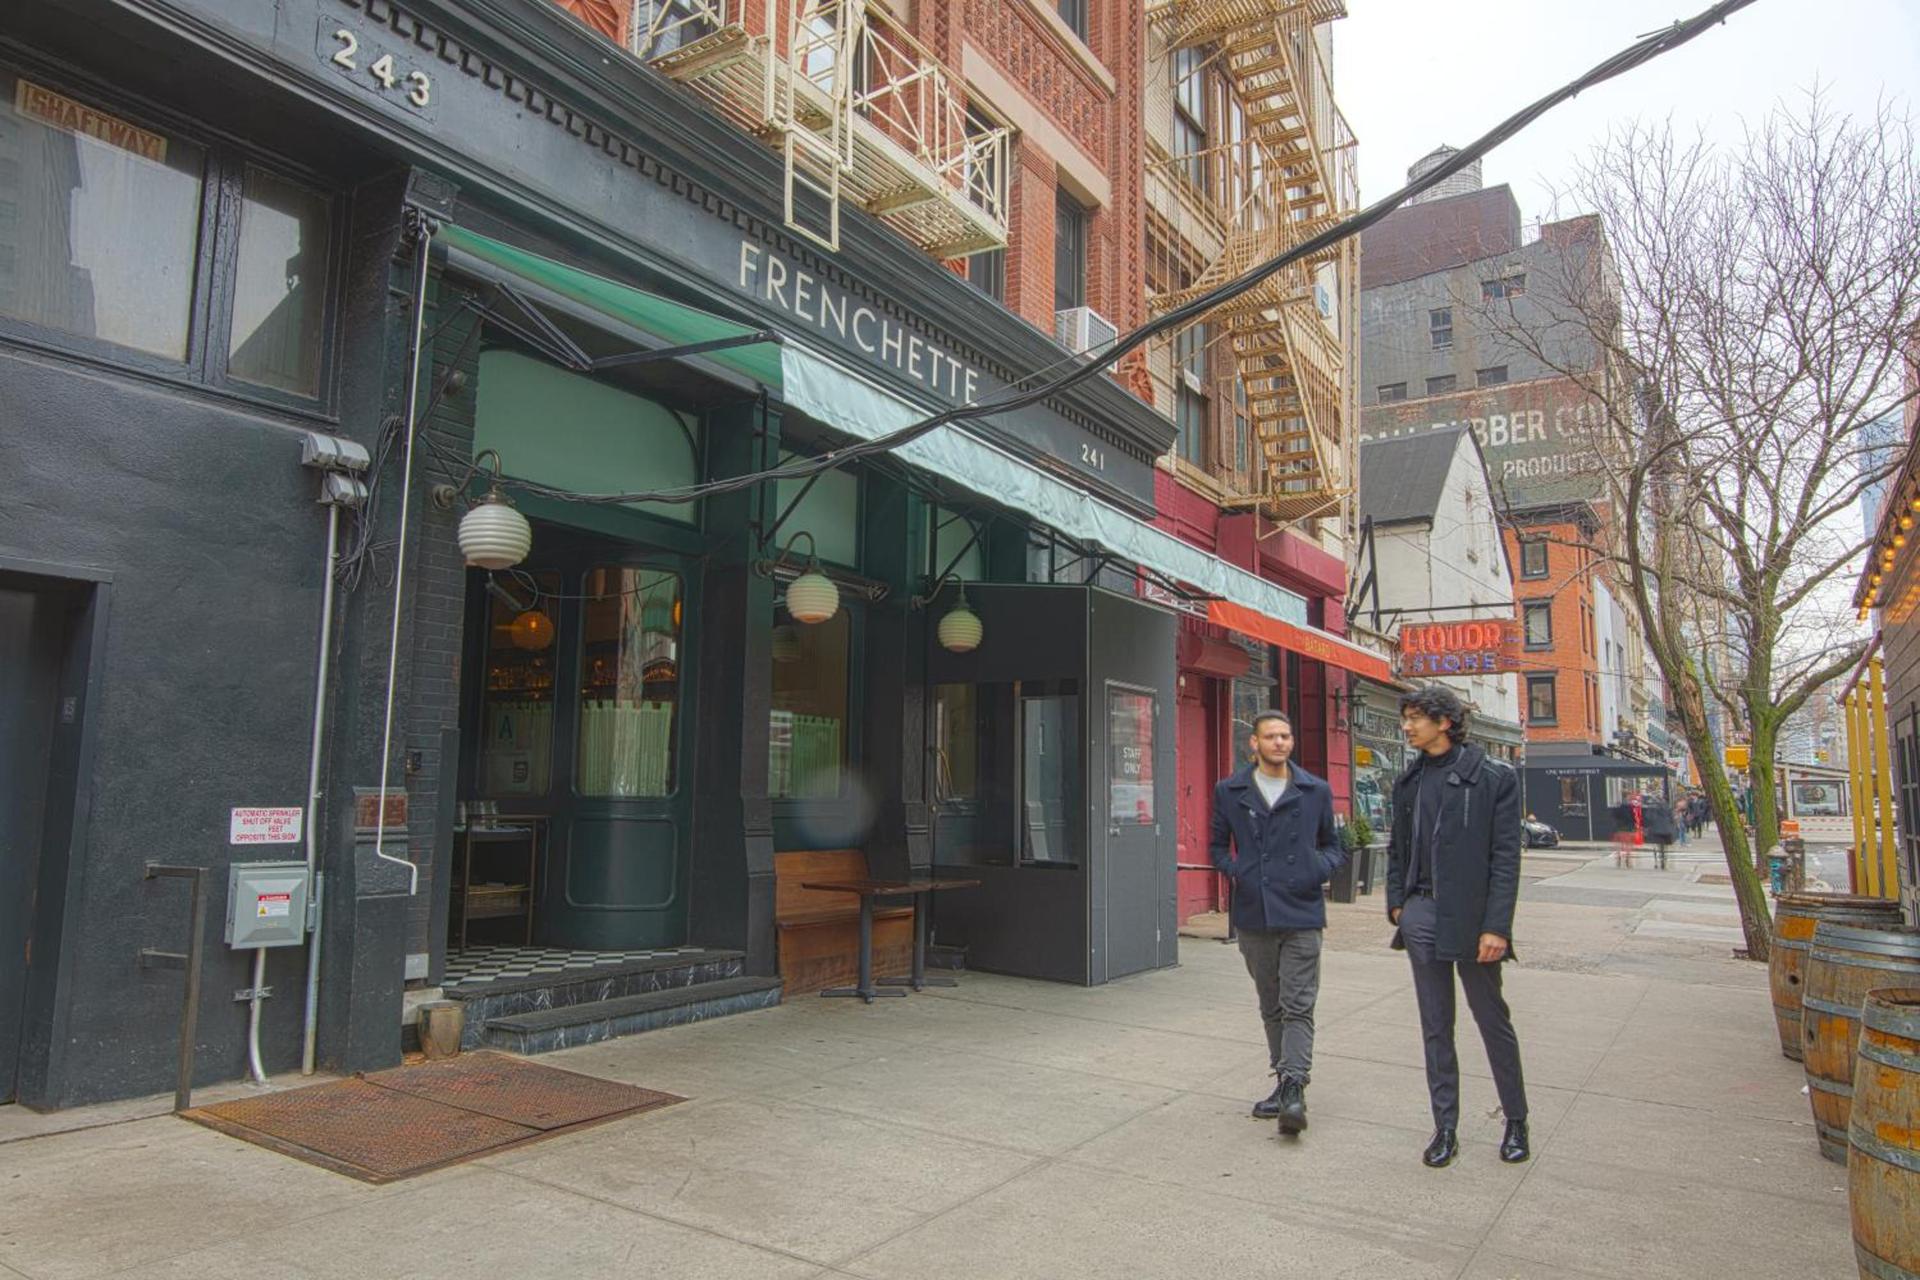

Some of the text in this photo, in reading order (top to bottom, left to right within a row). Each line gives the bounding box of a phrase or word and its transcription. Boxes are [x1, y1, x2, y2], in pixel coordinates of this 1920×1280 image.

[333, 29, 430, 107] 243
[33, 87, 158, 160] SHAFTWAY
[739, 240, 979, 407] FRENCHETTE
[1081, 443, 1104, 471] 241
[1402, 623, 1501, 652] LIQUOR
[1413, 652, 1497, 673] STORE
[1123, 746, 1141, 759] STAFF
[1124, 762, 1141, 774] ONLY
[235, 809, 267, 817] AUTOMATIC
[242, 817, 291, 825] SHUT OFF VALVE
[235, 833, 266, 841] OPPOSITE
[281, 832, 296, 840] SIGN
